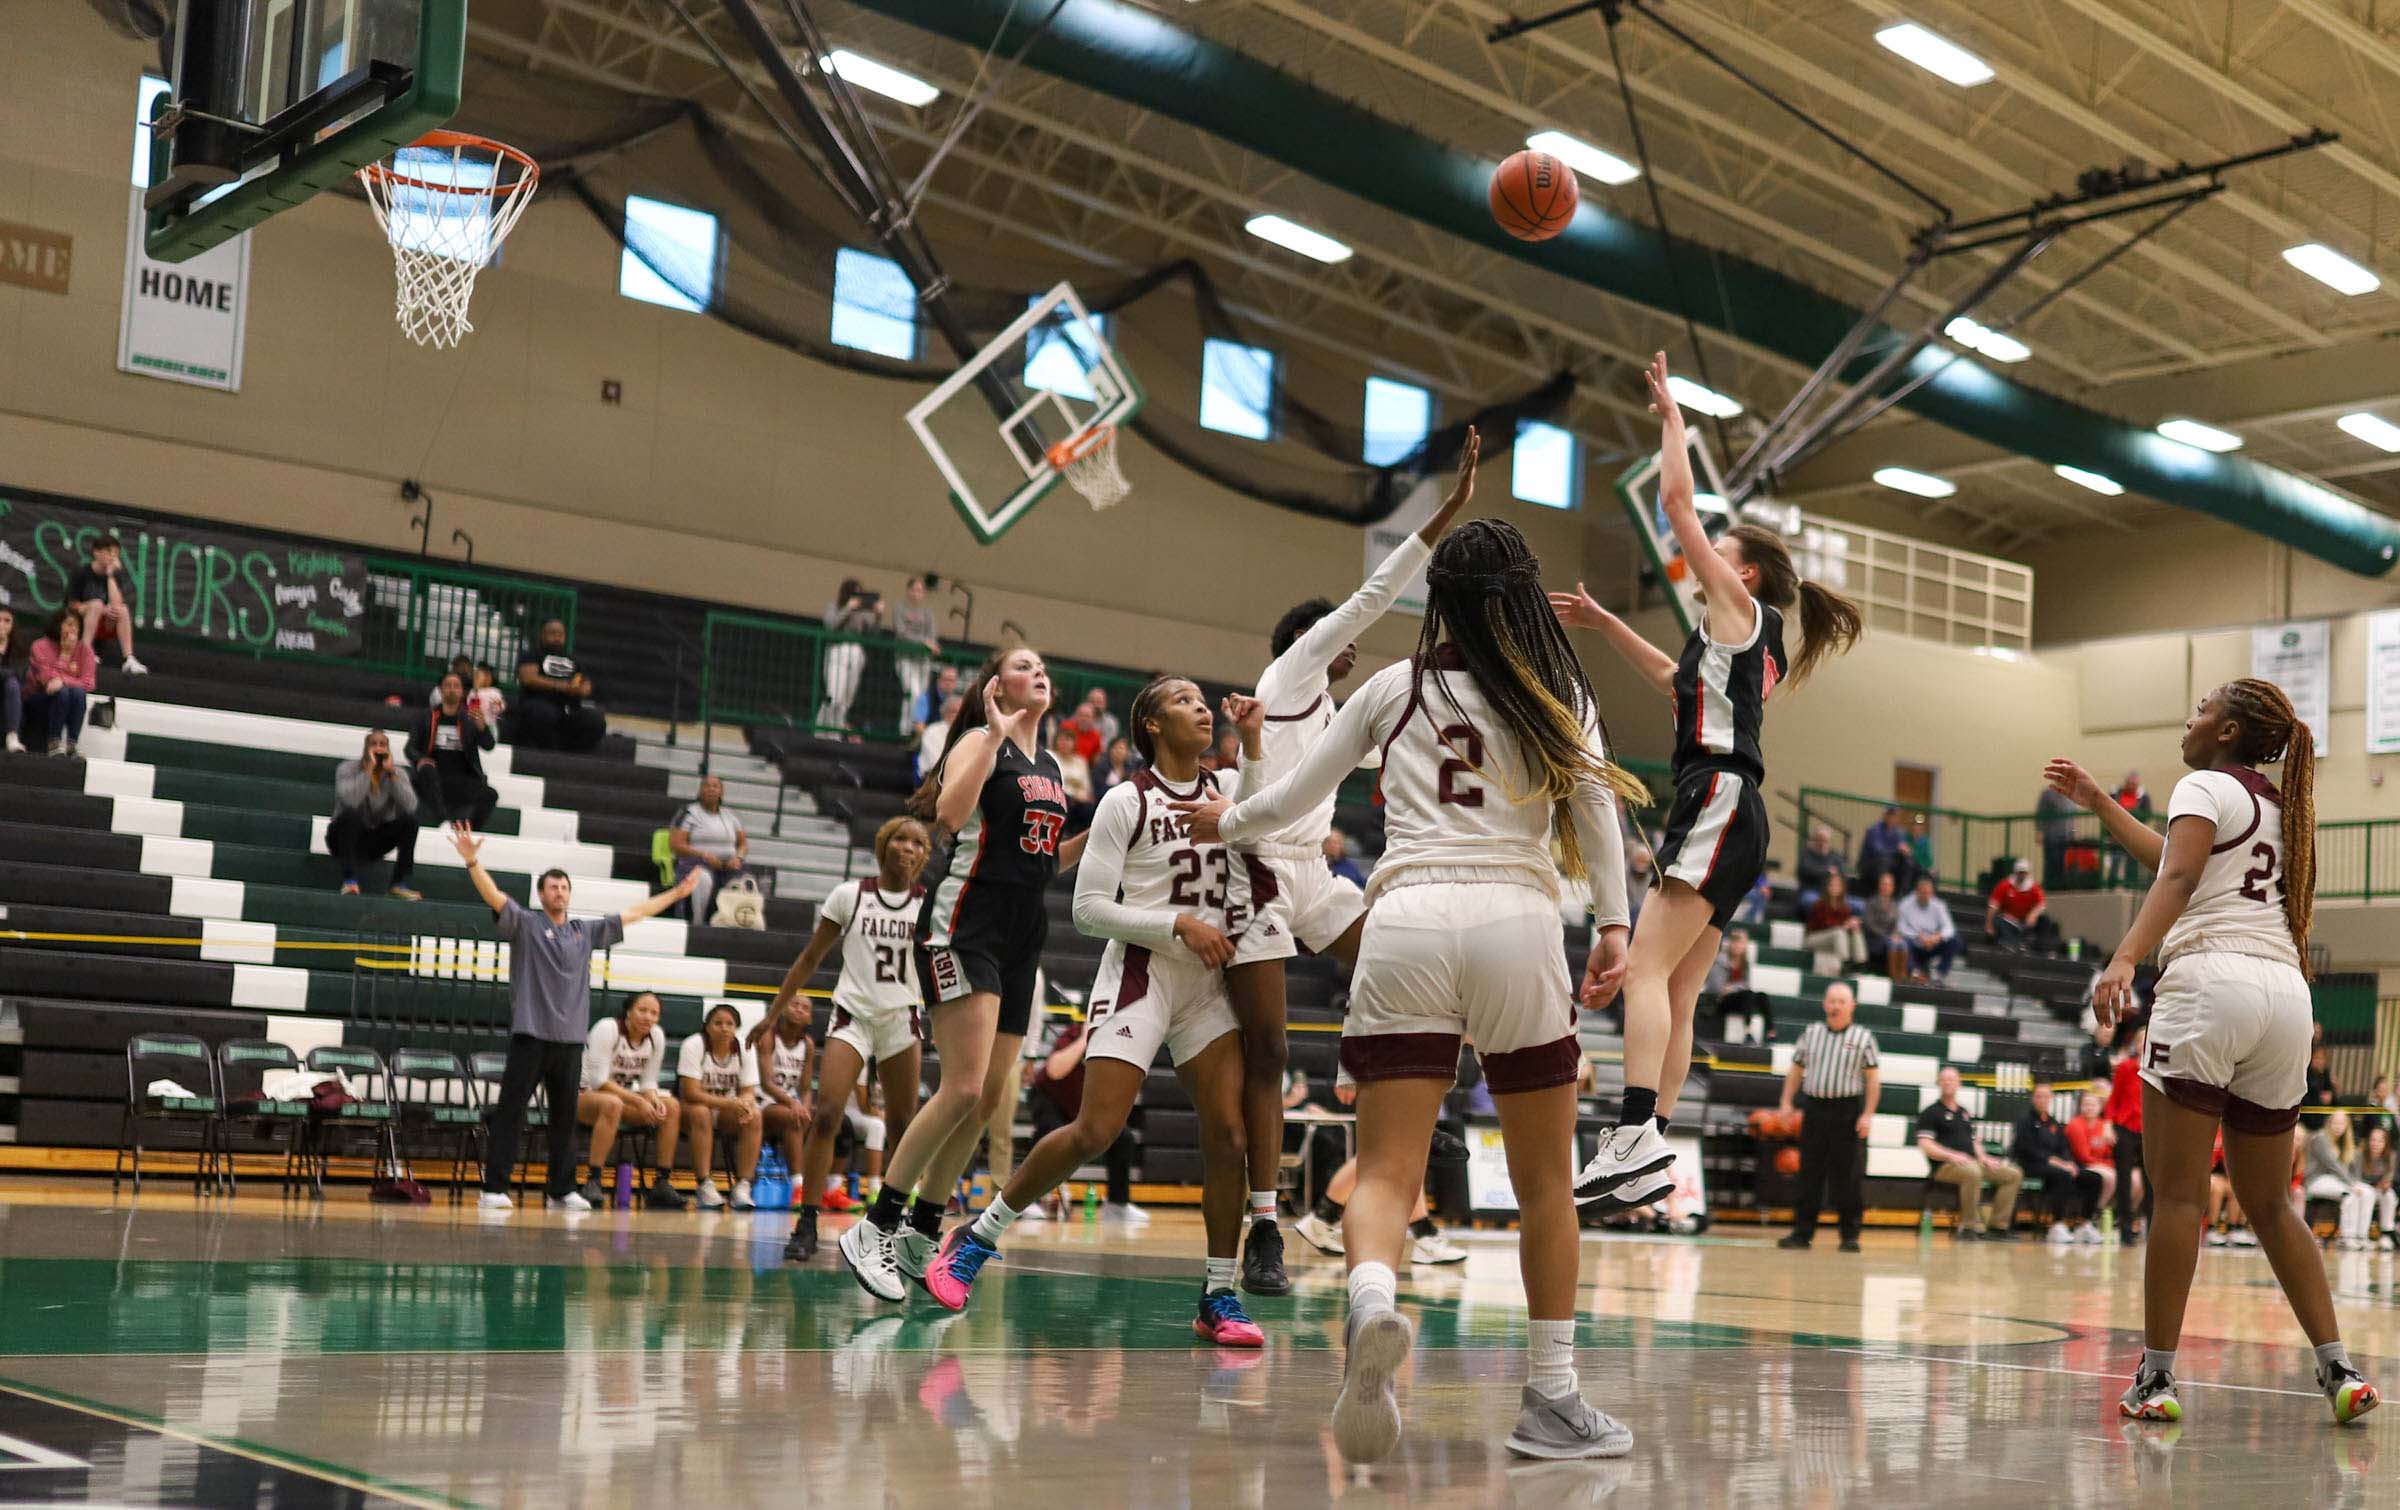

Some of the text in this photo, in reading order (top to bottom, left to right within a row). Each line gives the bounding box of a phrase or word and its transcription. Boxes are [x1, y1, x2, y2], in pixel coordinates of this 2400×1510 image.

[140, 267, 233, 315] HOME
[1438, 724, 1484, 807] 2
[1019, 808, 1066, 857] 33
[1168, 847, 1231, 910] 23
[2239, 840, 2277, 904] 2
[1226, 904, 1249, 930] F
[874, 943, 908, 984] 21
[1090, 999, 1110, 1023] F
[2148, 1041, 2171, 1069] F
